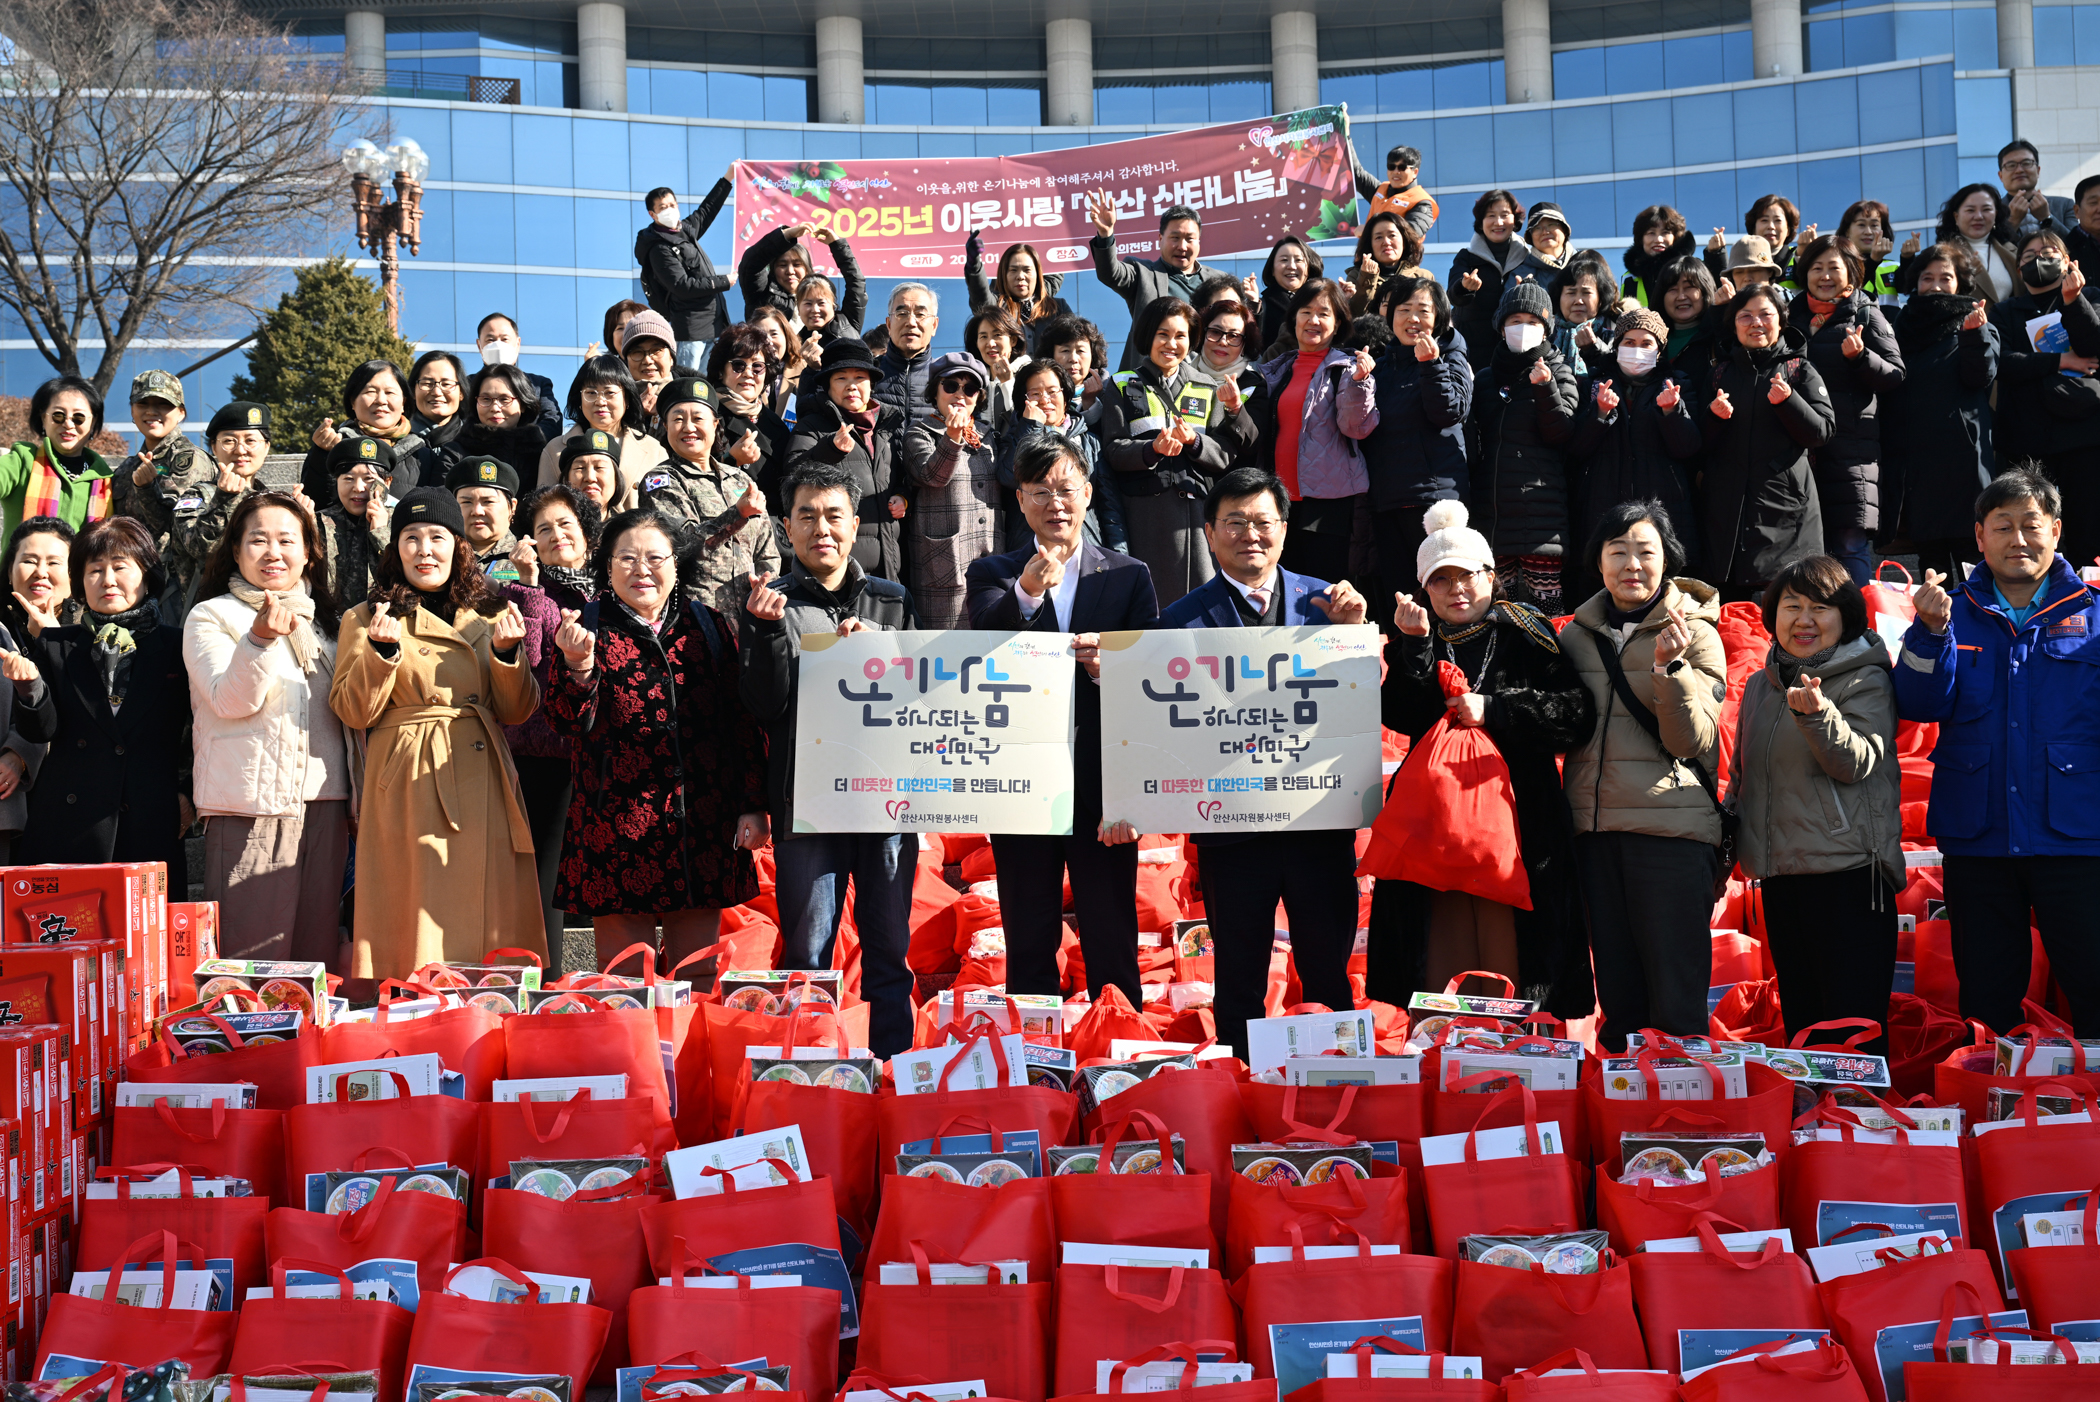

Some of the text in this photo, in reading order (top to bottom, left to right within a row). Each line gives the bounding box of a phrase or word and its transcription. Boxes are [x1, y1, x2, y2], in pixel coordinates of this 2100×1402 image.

[916, 159, 1180, 196] 이웃을 위한 온기나눔에 참여해주셔서 감사합니다.
[811, 204, 934, 238] 2025년
[940, 196, 1065, 233] 이웃사랑
[1152, 168, 1289, 216] 산타나눔』
[910, 256, 933, 265] 일자
[1056, 249, 1079, 259] 장소
[2049, 626, 2085, 635] BEST DRIVER
[838, 656, 1032, 729] 온기나눔
[1142, 653, 1339, 728] 온기나눔
[895, 706, 980, 735] 하나되는
[1203, 706, 1288, 733] 하나되는
[910, 734, 1001, 765] 대한민국
[1220, 733, 1310, 764] 대한민국
[834, 778, 1031, 793] 더 따뜻한 대한민국을 만듭니다!
[1144, 775, 1342, 794] 더 따뜻한 대한민국을 만듭니다!
[900, 813, 978, 824] 안산시자원봉사센터
[1213, 812, 1291, 823] 안산시자원봉사센터
[31, 883, 60, 894] 농심
[175, 931, 186, 957] 농심
[1486, 1001, 1526, 1010] 육개장
[249, 1013, 290, 1024] 육개장
[1811, 1056, 1875, 1074] 육개장 사발면
[1837, 1070, 1854, 1078] 농심
